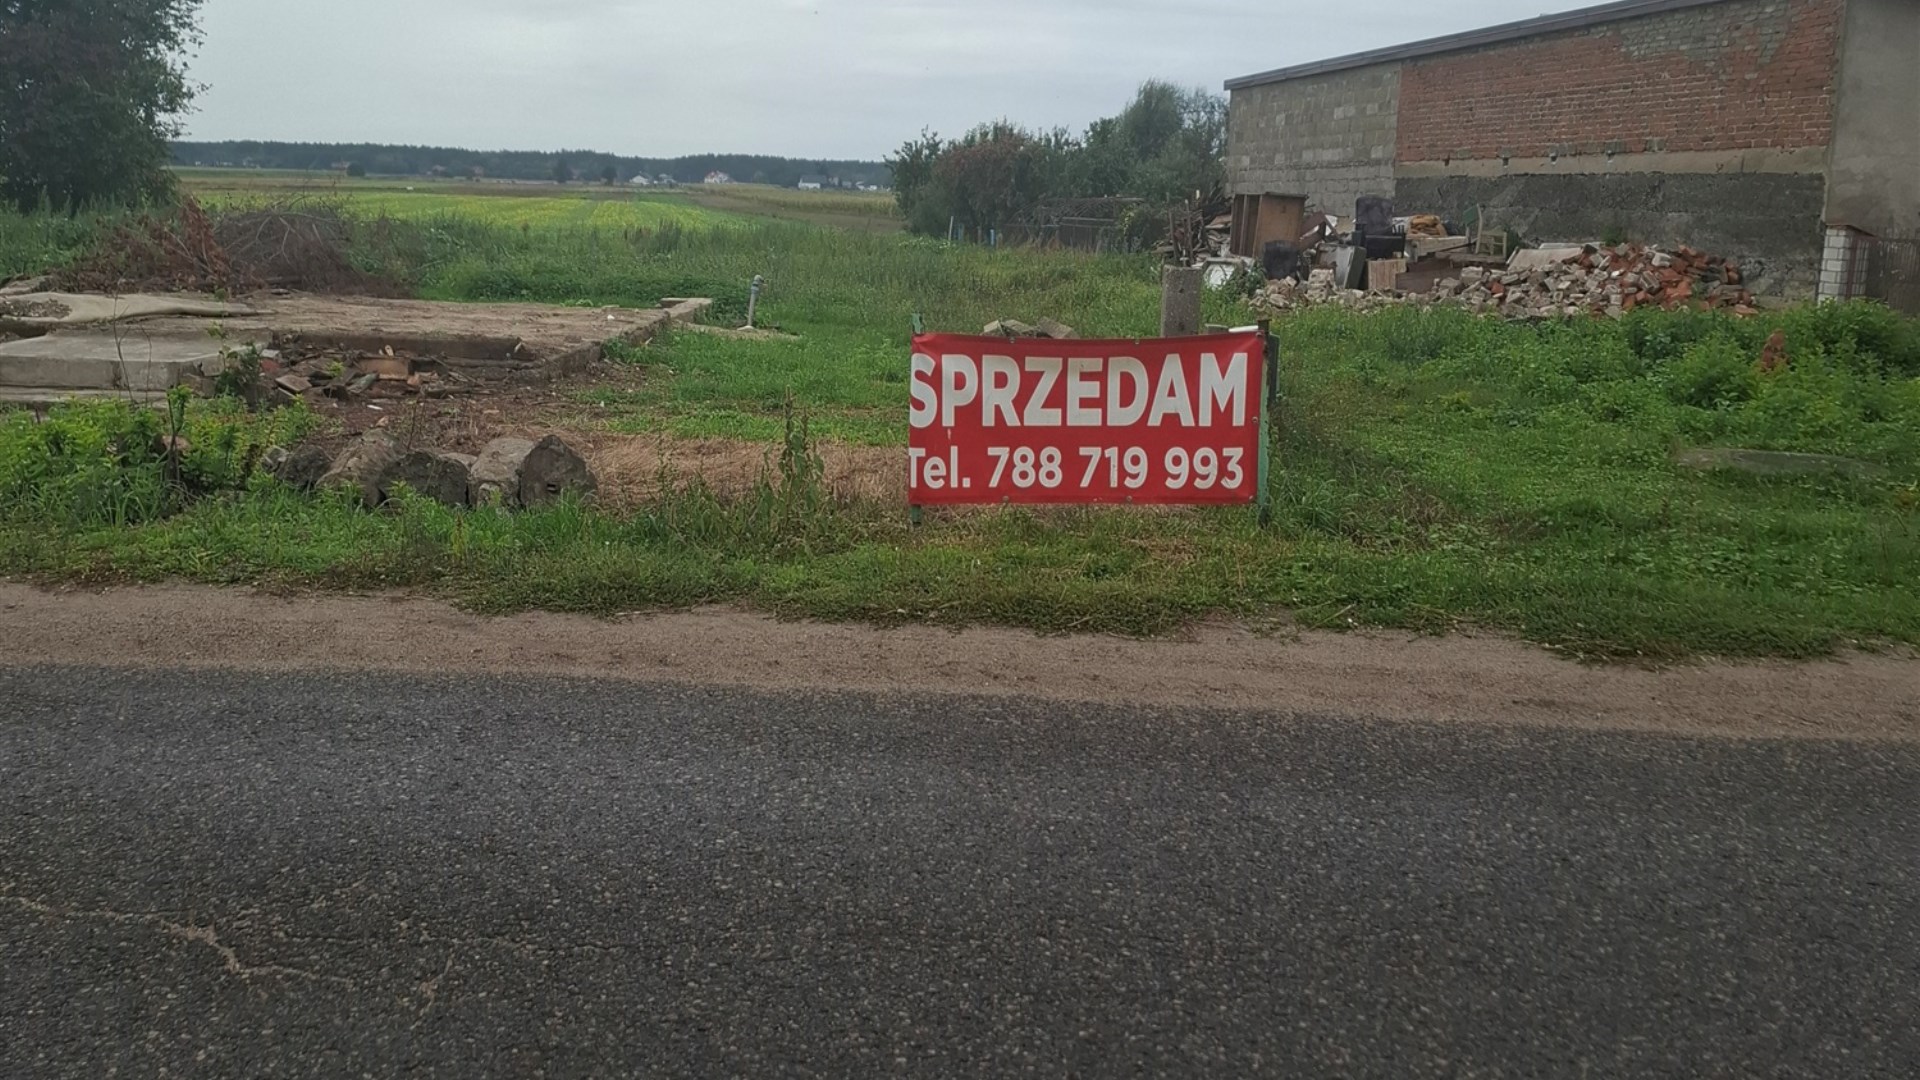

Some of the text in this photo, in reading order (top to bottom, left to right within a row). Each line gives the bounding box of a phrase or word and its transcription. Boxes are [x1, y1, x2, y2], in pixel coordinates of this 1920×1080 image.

[909, 352, 1248, 428] SPRZEDAM
[908, 446, 1244, 490] Tel. 788 719 993
